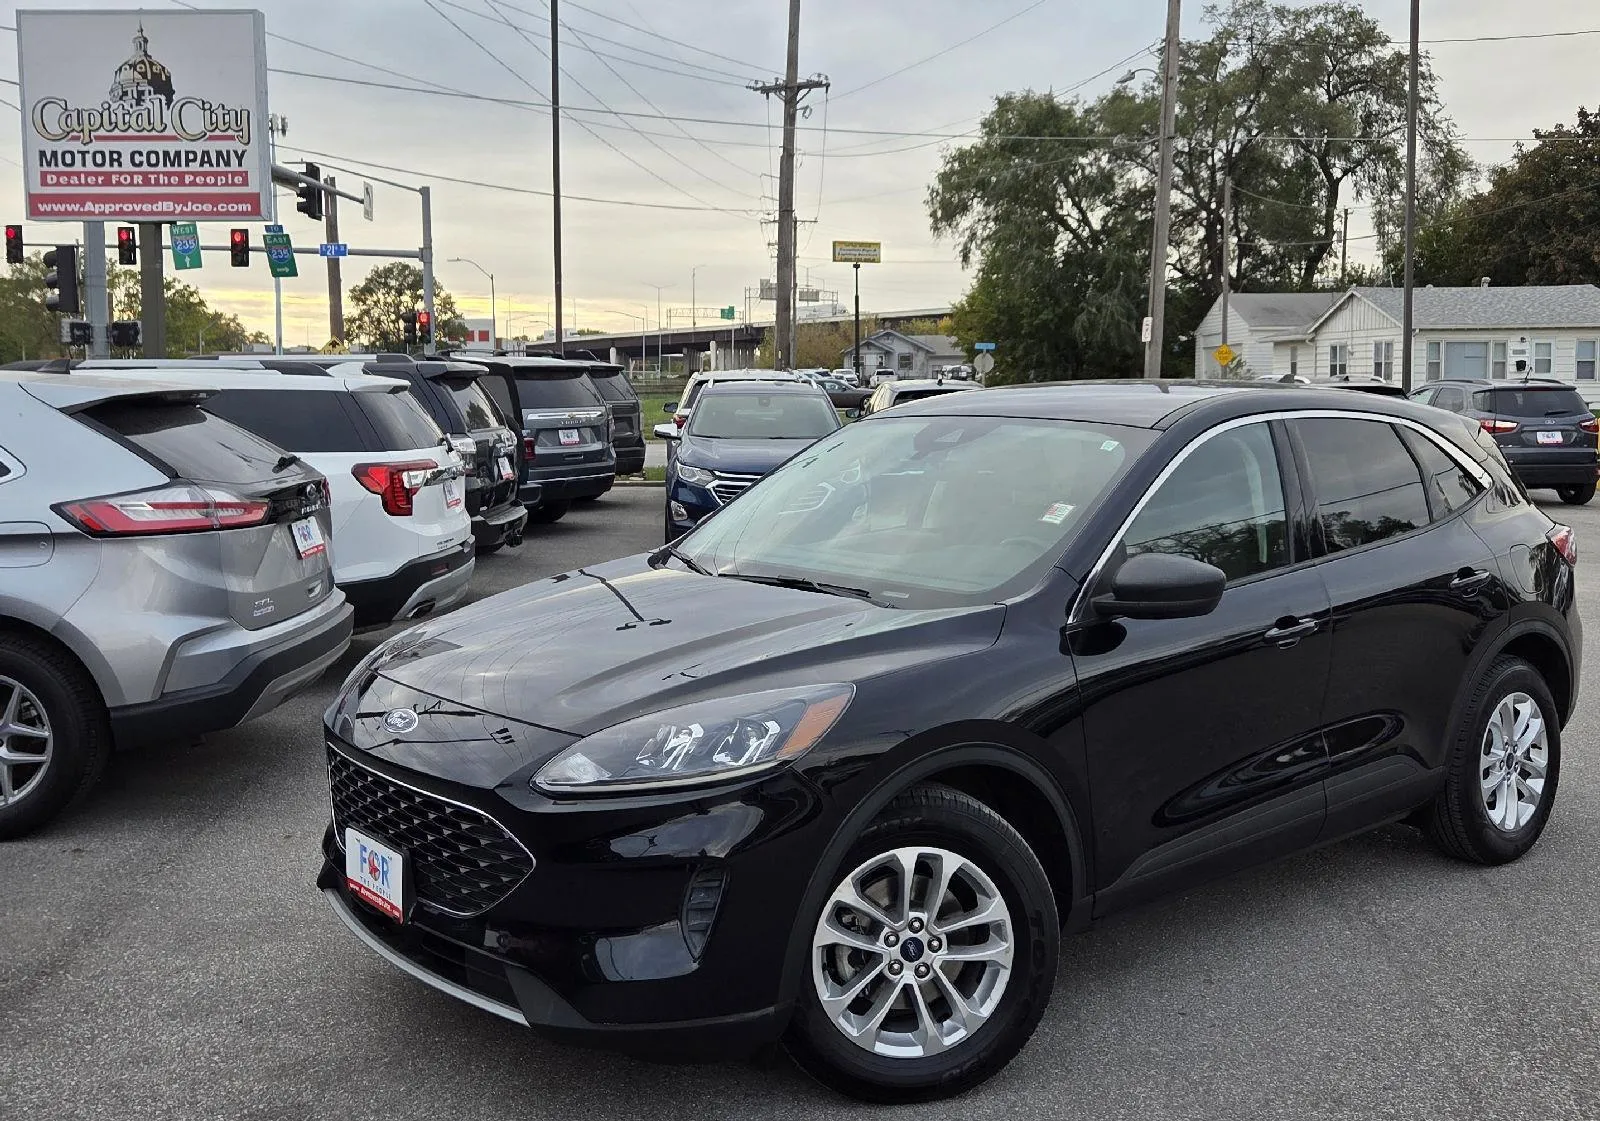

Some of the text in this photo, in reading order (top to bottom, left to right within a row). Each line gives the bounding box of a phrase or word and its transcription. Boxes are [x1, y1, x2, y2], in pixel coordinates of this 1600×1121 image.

[32, 95, 251, 145] Capital City
[39, 149, 247, 168] MOTOR COMPANY
[46, 173, 243, 186] Dealer FOR The People
[38, 200, 252, 214] www.ApprovedByJoe.com
[176, 239, 196, 250] 235
[271, 249, 289, 259] 235
[387, 711, 410, 728] Ford
[359, 844, 391, 889] FOR
